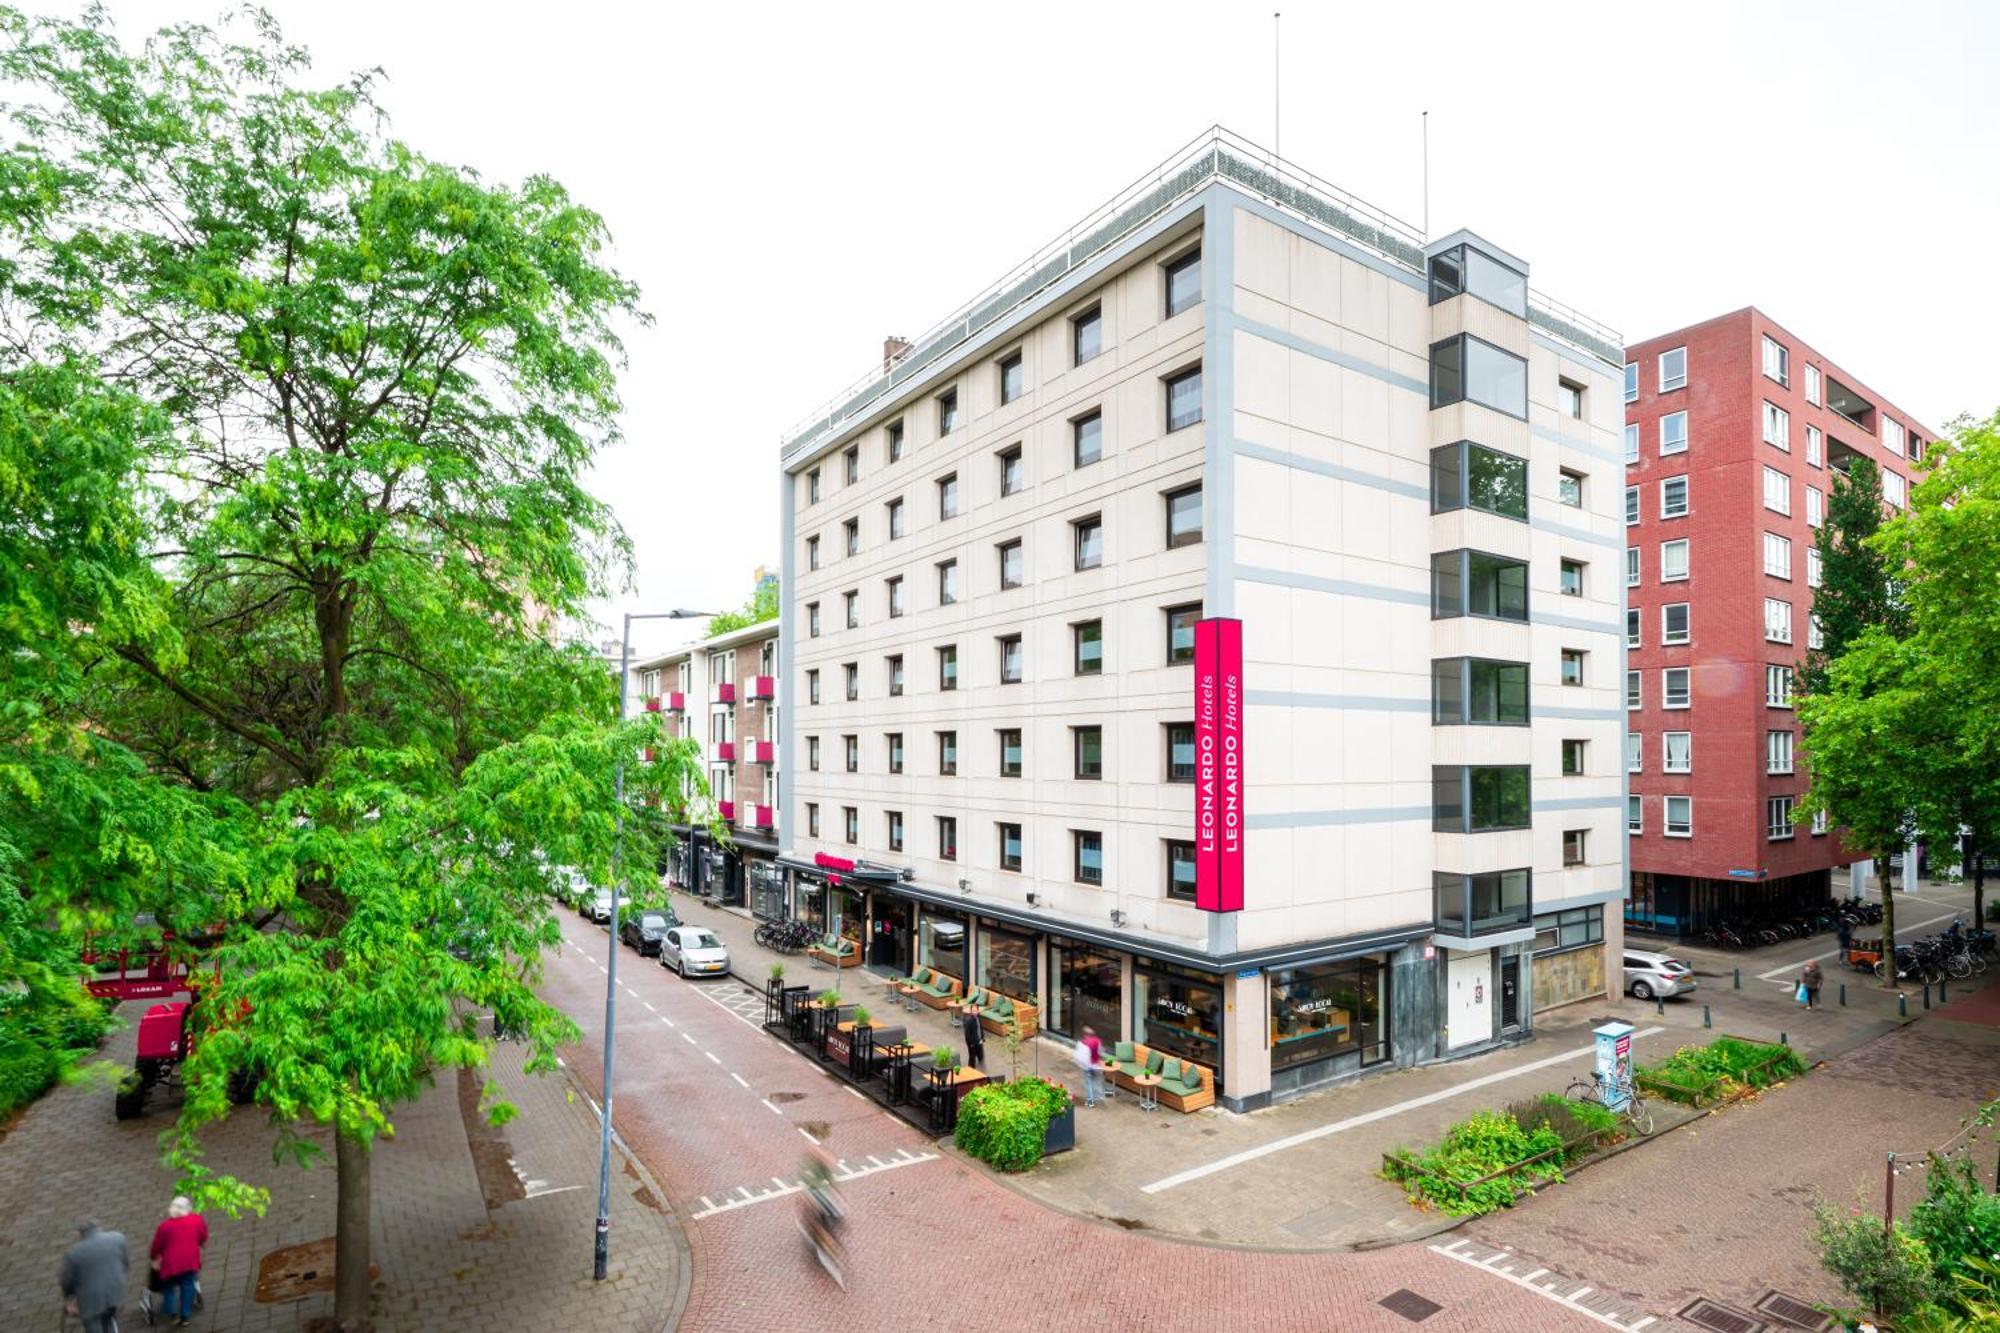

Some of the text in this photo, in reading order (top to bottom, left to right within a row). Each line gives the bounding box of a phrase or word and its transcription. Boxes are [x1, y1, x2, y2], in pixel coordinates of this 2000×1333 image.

[1201, 674, 1214, 852] LEONARDO Hotels
[1225, 674, 1238, 853] LEONARDO Hotels
